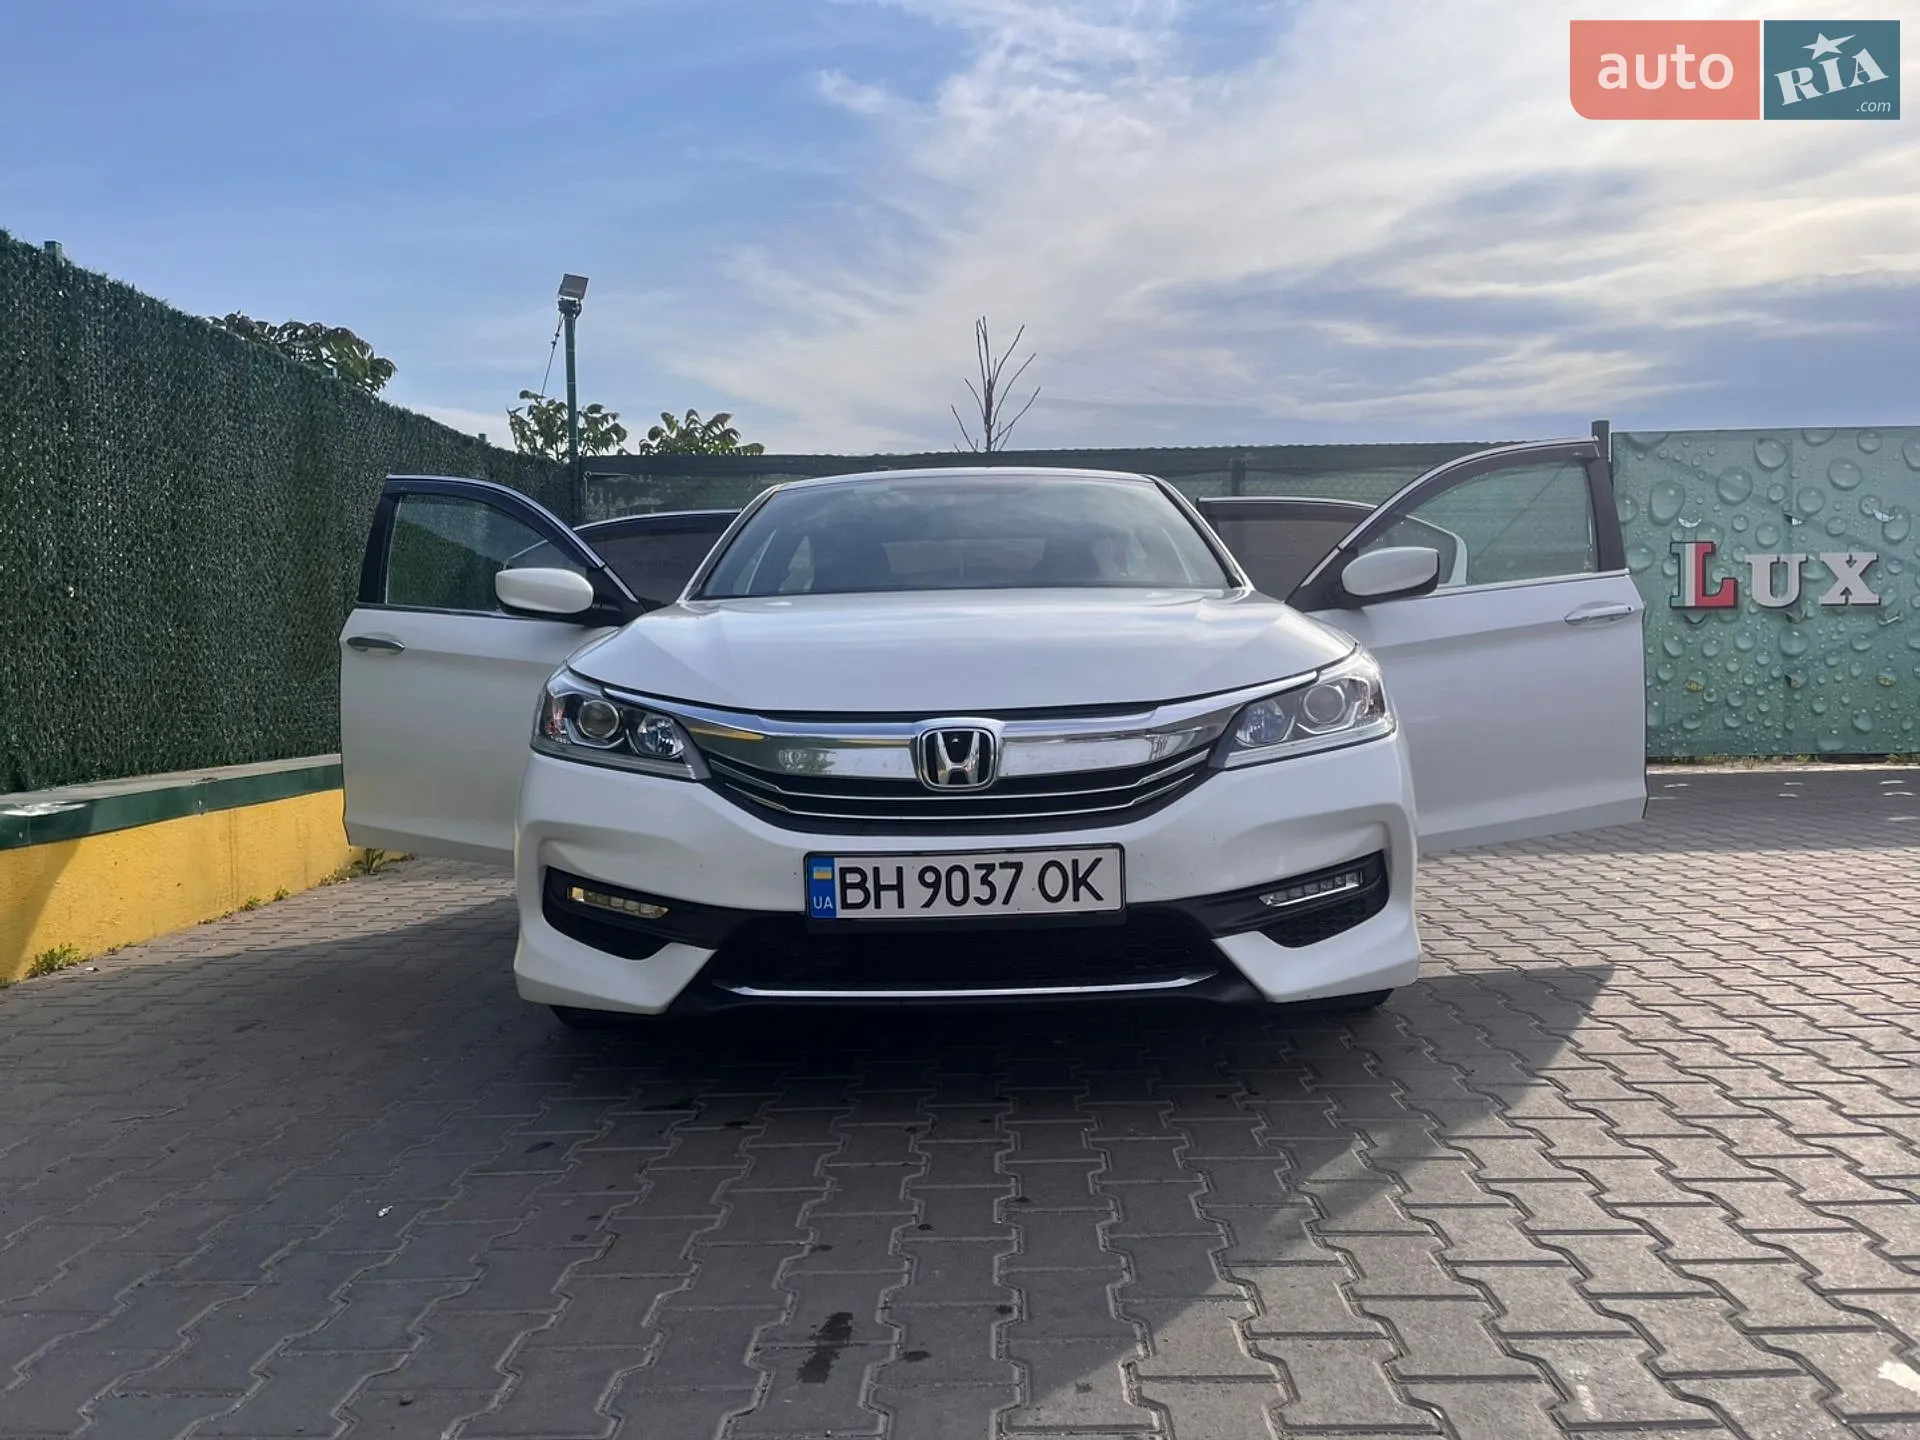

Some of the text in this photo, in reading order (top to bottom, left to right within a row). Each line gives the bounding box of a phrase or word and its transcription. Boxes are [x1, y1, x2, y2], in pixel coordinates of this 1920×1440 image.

[838, 857, 1104, 910] BH 9037 OK
[813, 896, 833, 910] UA
